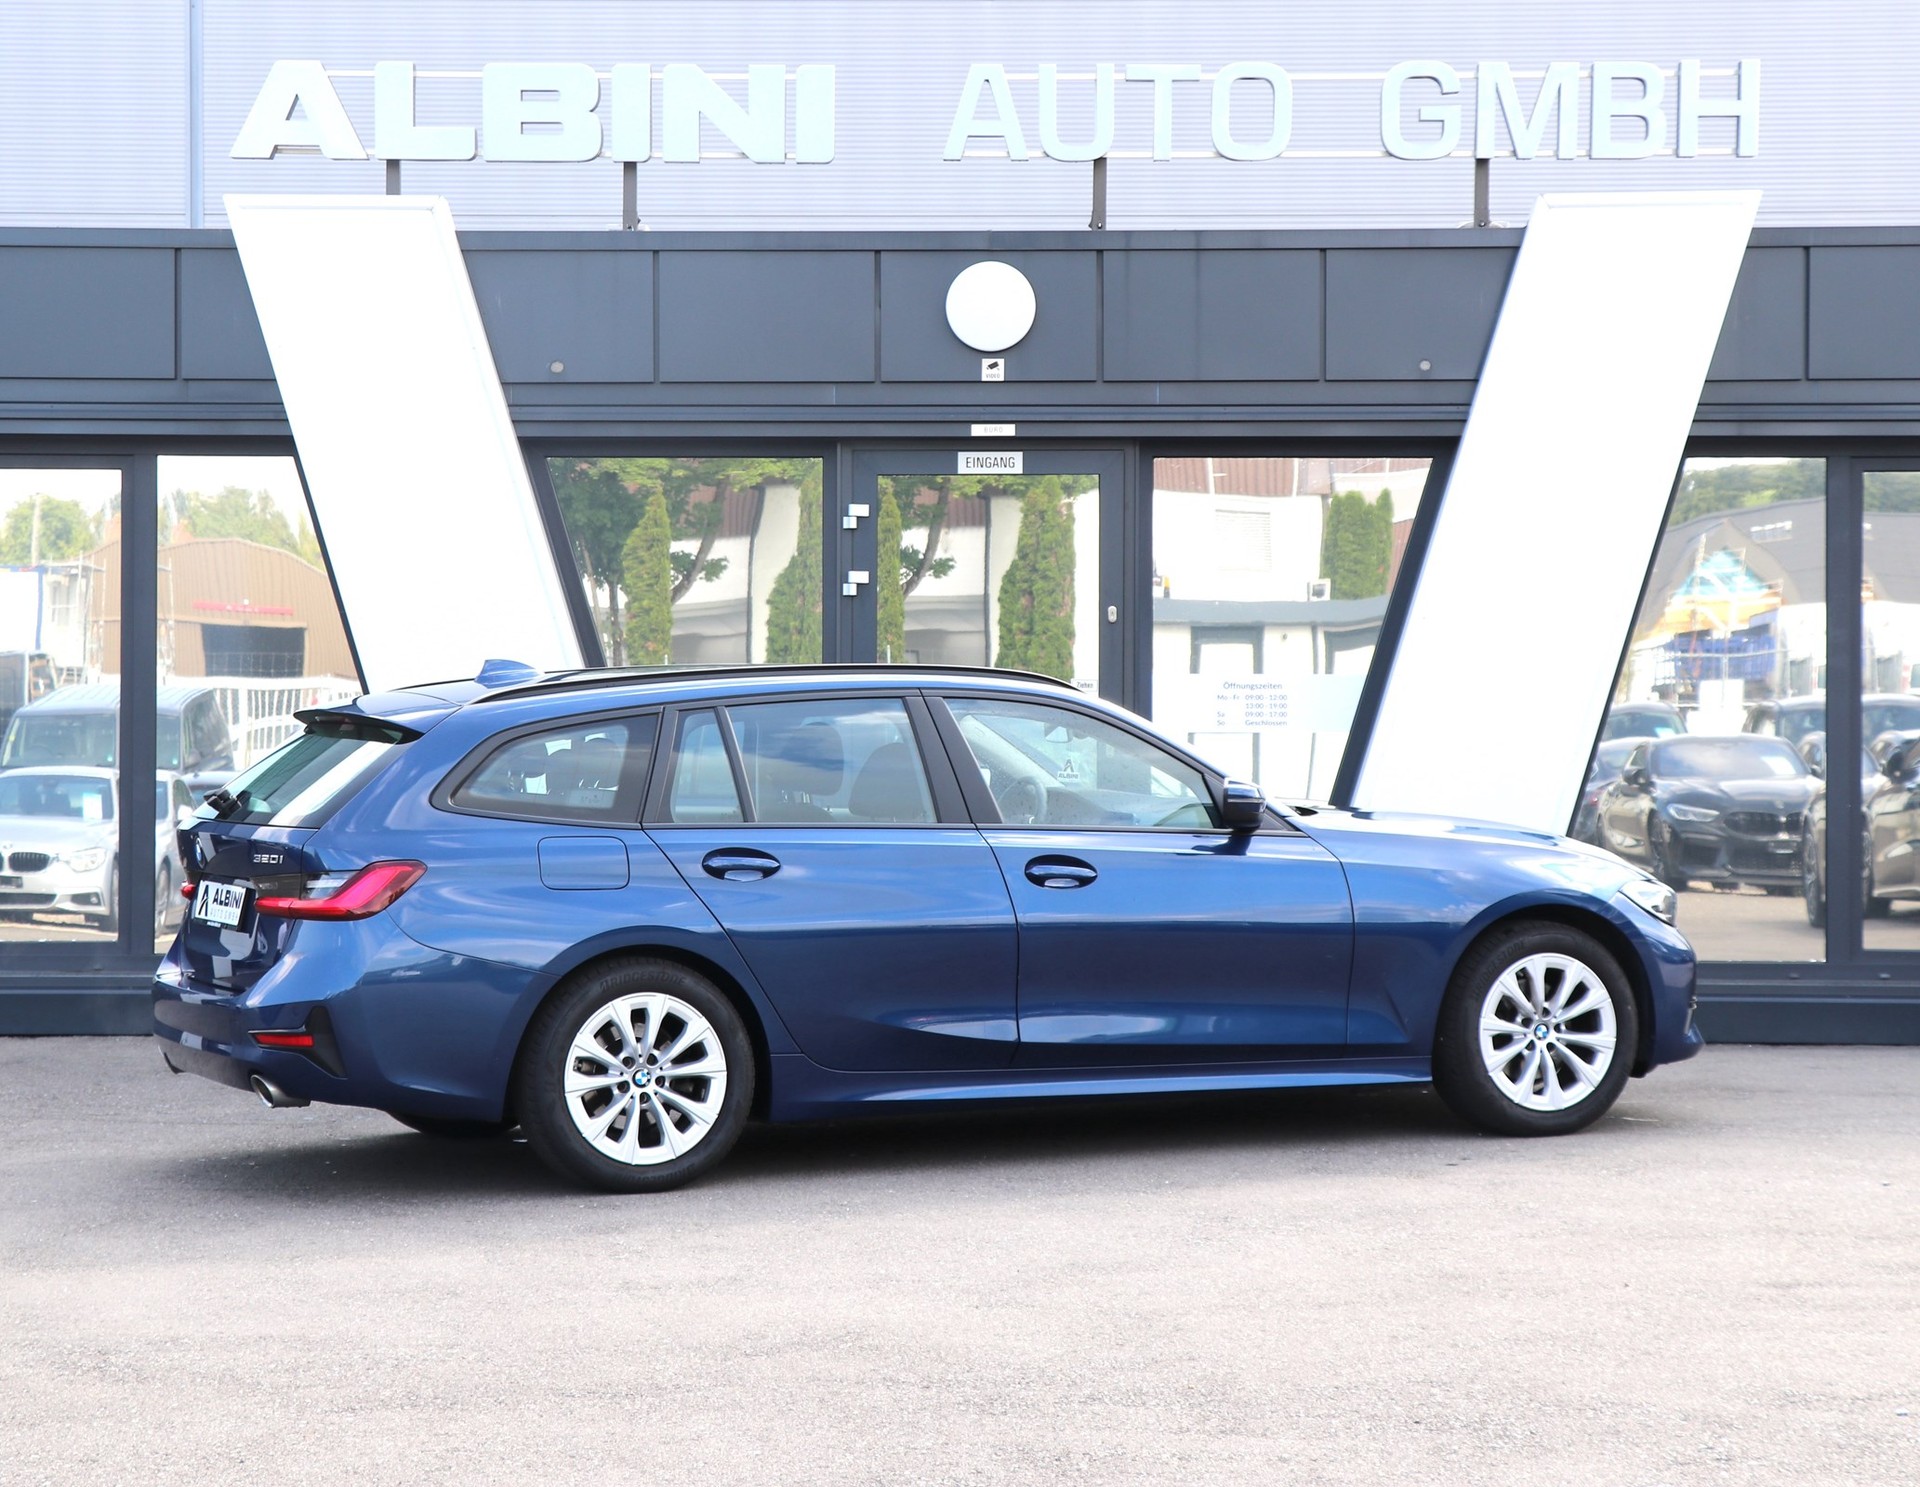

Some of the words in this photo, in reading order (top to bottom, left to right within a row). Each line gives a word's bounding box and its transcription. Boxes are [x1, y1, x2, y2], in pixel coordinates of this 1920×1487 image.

[229, 59, 836, 164] ALBINI
[943, 60, 1294, 162] AUTO
[1380, 58, 1761, 161] GMBH
[965, 456, 1015, 469] EINGANG
[1223, 681, 1283, 691] Öffnungszeiten
[212, 888, 243, 909] ALBINI
[599, 970, 688, 992] BRIDGESTONE
